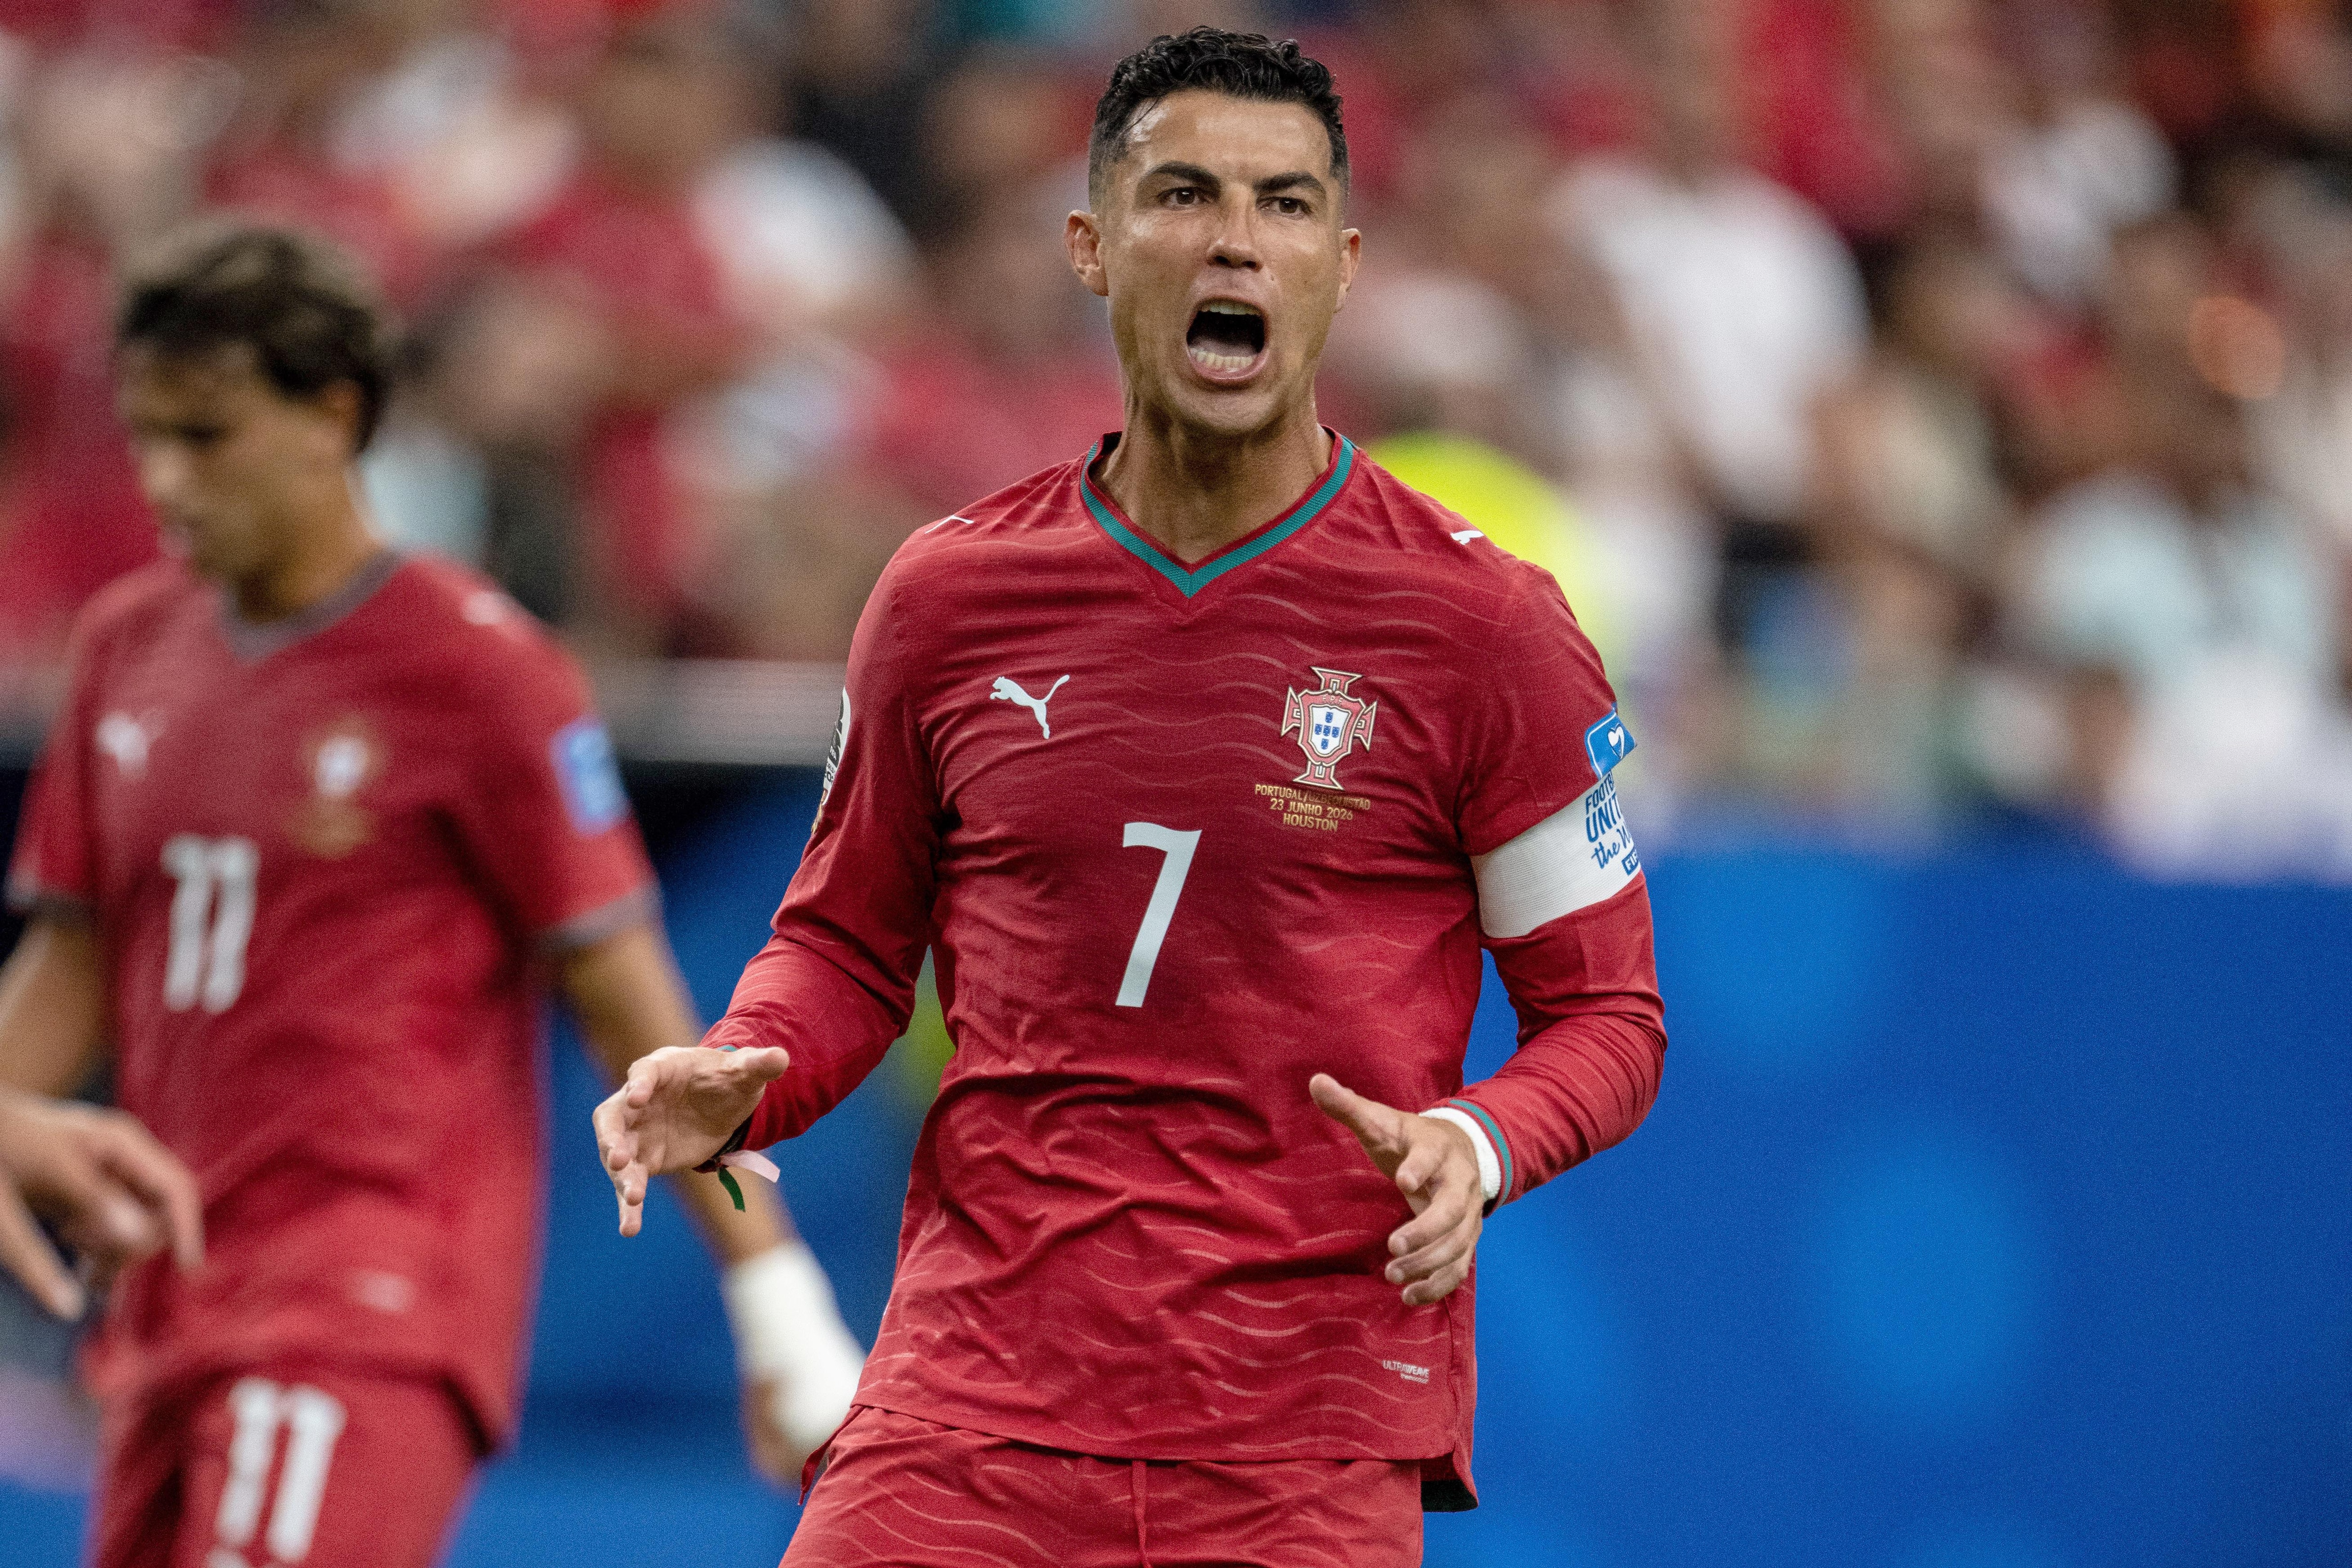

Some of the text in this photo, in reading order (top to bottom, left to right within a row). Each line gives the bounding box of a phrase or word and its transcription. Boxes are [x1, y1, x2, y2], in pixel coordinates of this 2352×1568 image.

[1270, 798, 1353, 820] 23 JUNHO 2026
[1283, 813, 1338, 832] HOUSTON
[1591, 841, 1620, 869] the
[162, 835, 259, 1013] 11
[1115, 822, 1202, 1007] 7
[215, 1377, 347, 1563] 11
